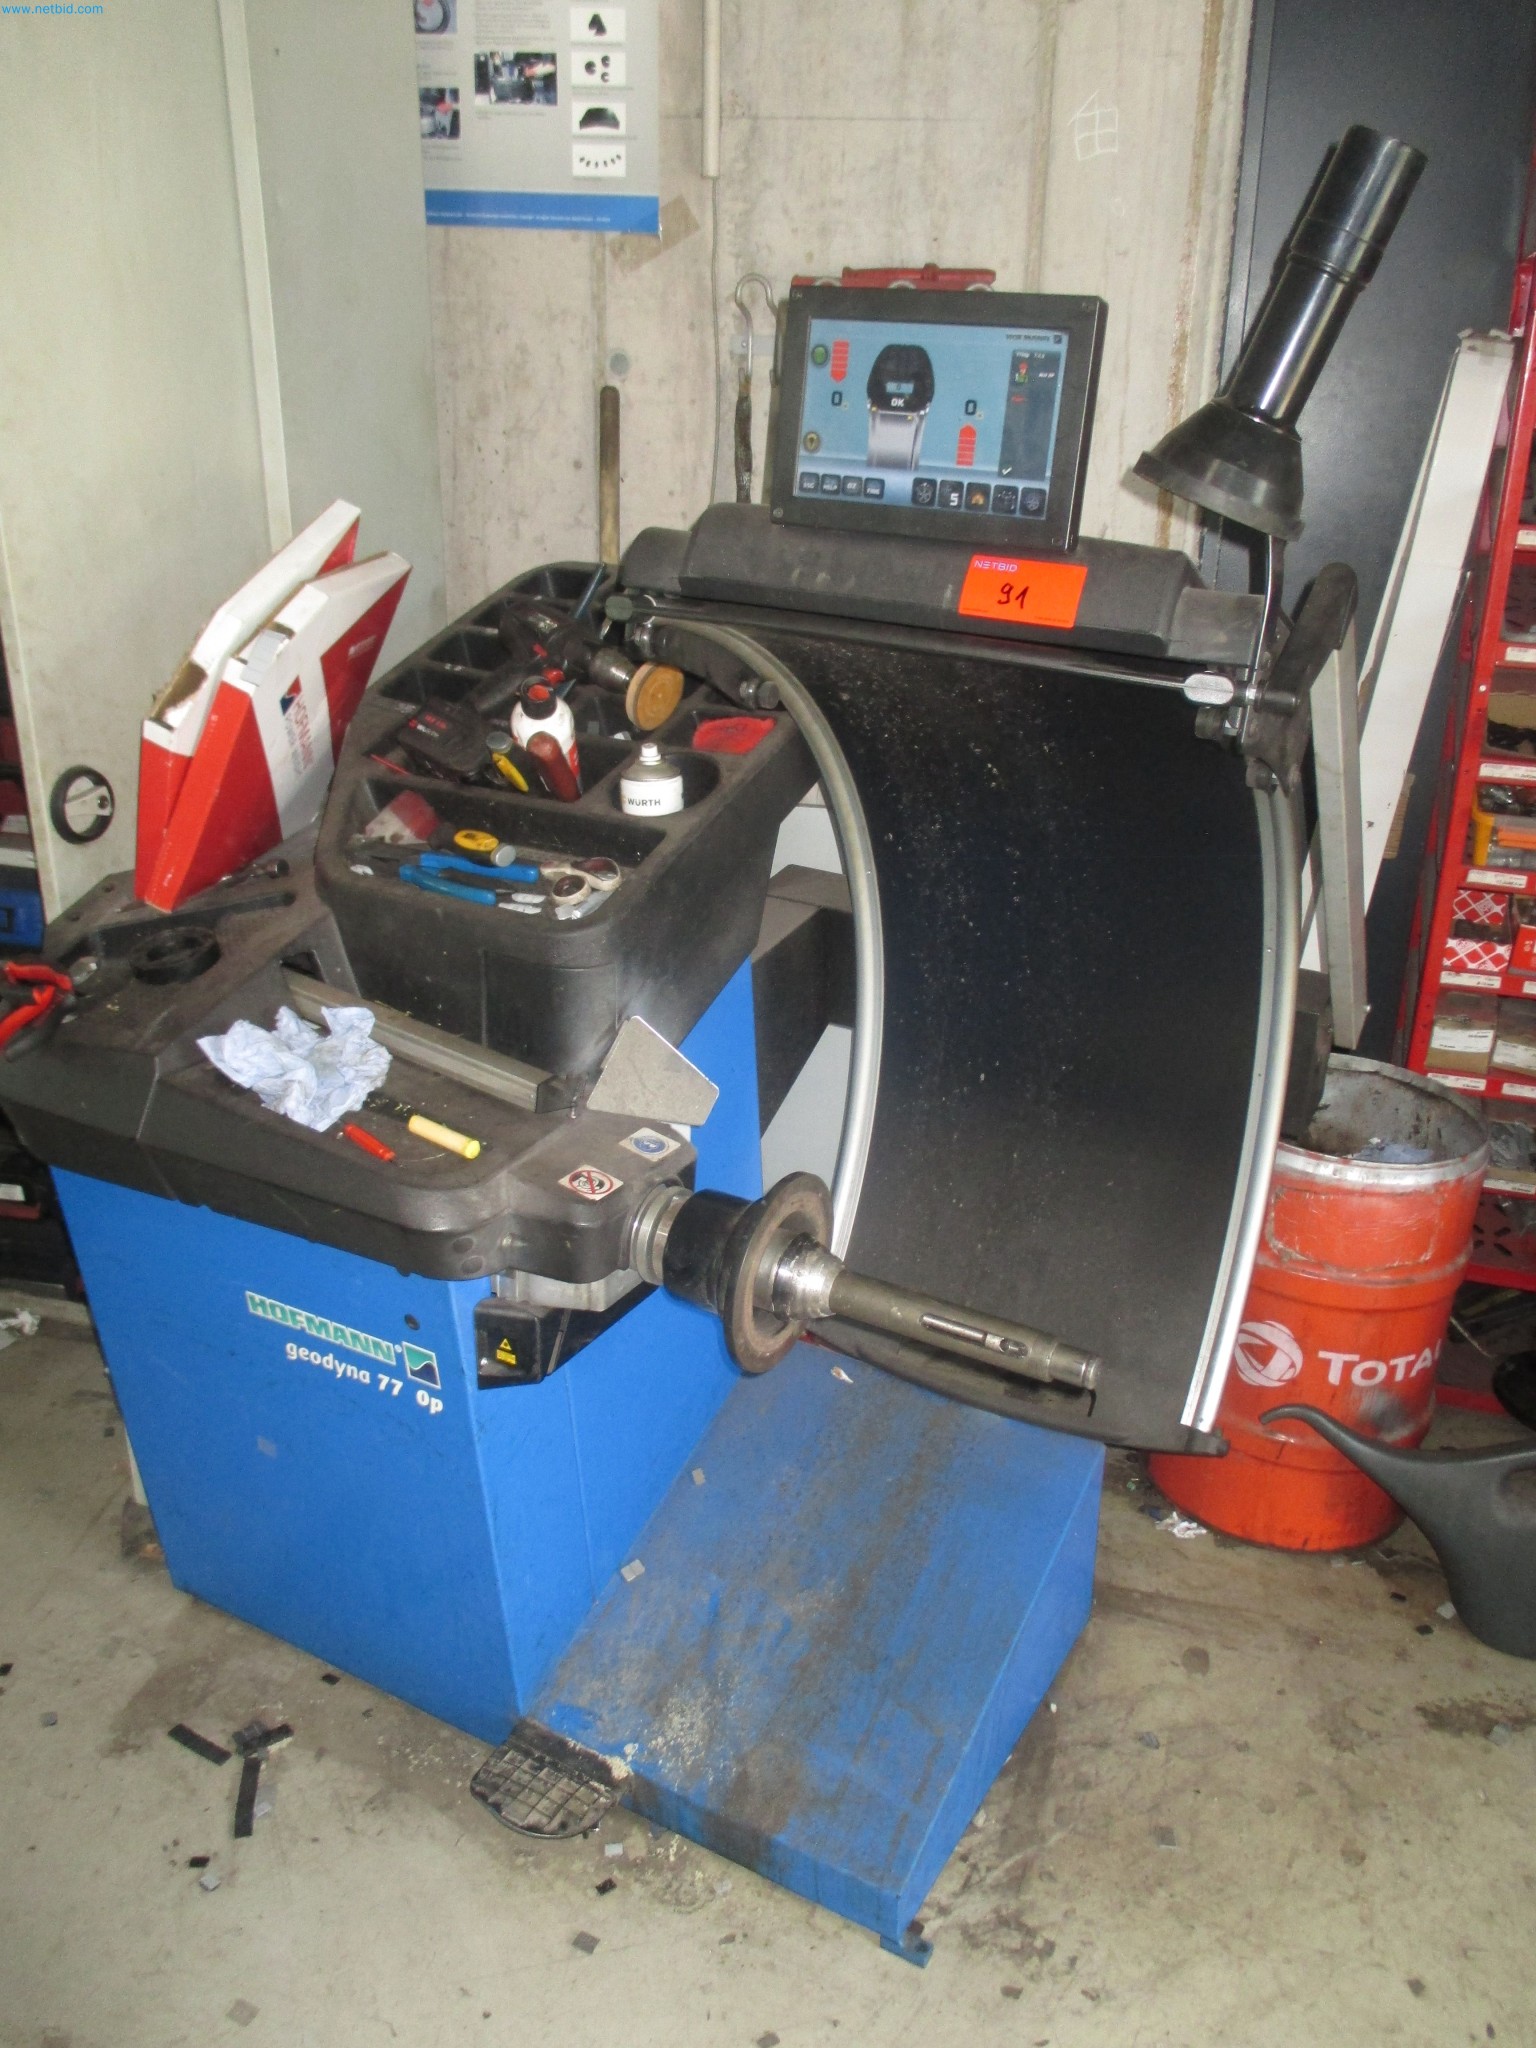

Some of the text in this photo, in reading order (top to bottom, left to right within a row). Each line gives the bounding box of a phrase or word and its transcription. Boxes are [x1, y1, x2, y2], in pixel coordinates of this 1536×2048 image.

[891, 398, 904, 407] OK
[950, 493, 959, 506] 5
[975, 560, 1018, 572] NETBID
[997, 583, 1029, 609] 91
[246, 1291, 396, 1366] HOFMANN
[285, 1342, 371, 1385] geodyna
[377, 1373, 404, 1396] 77
